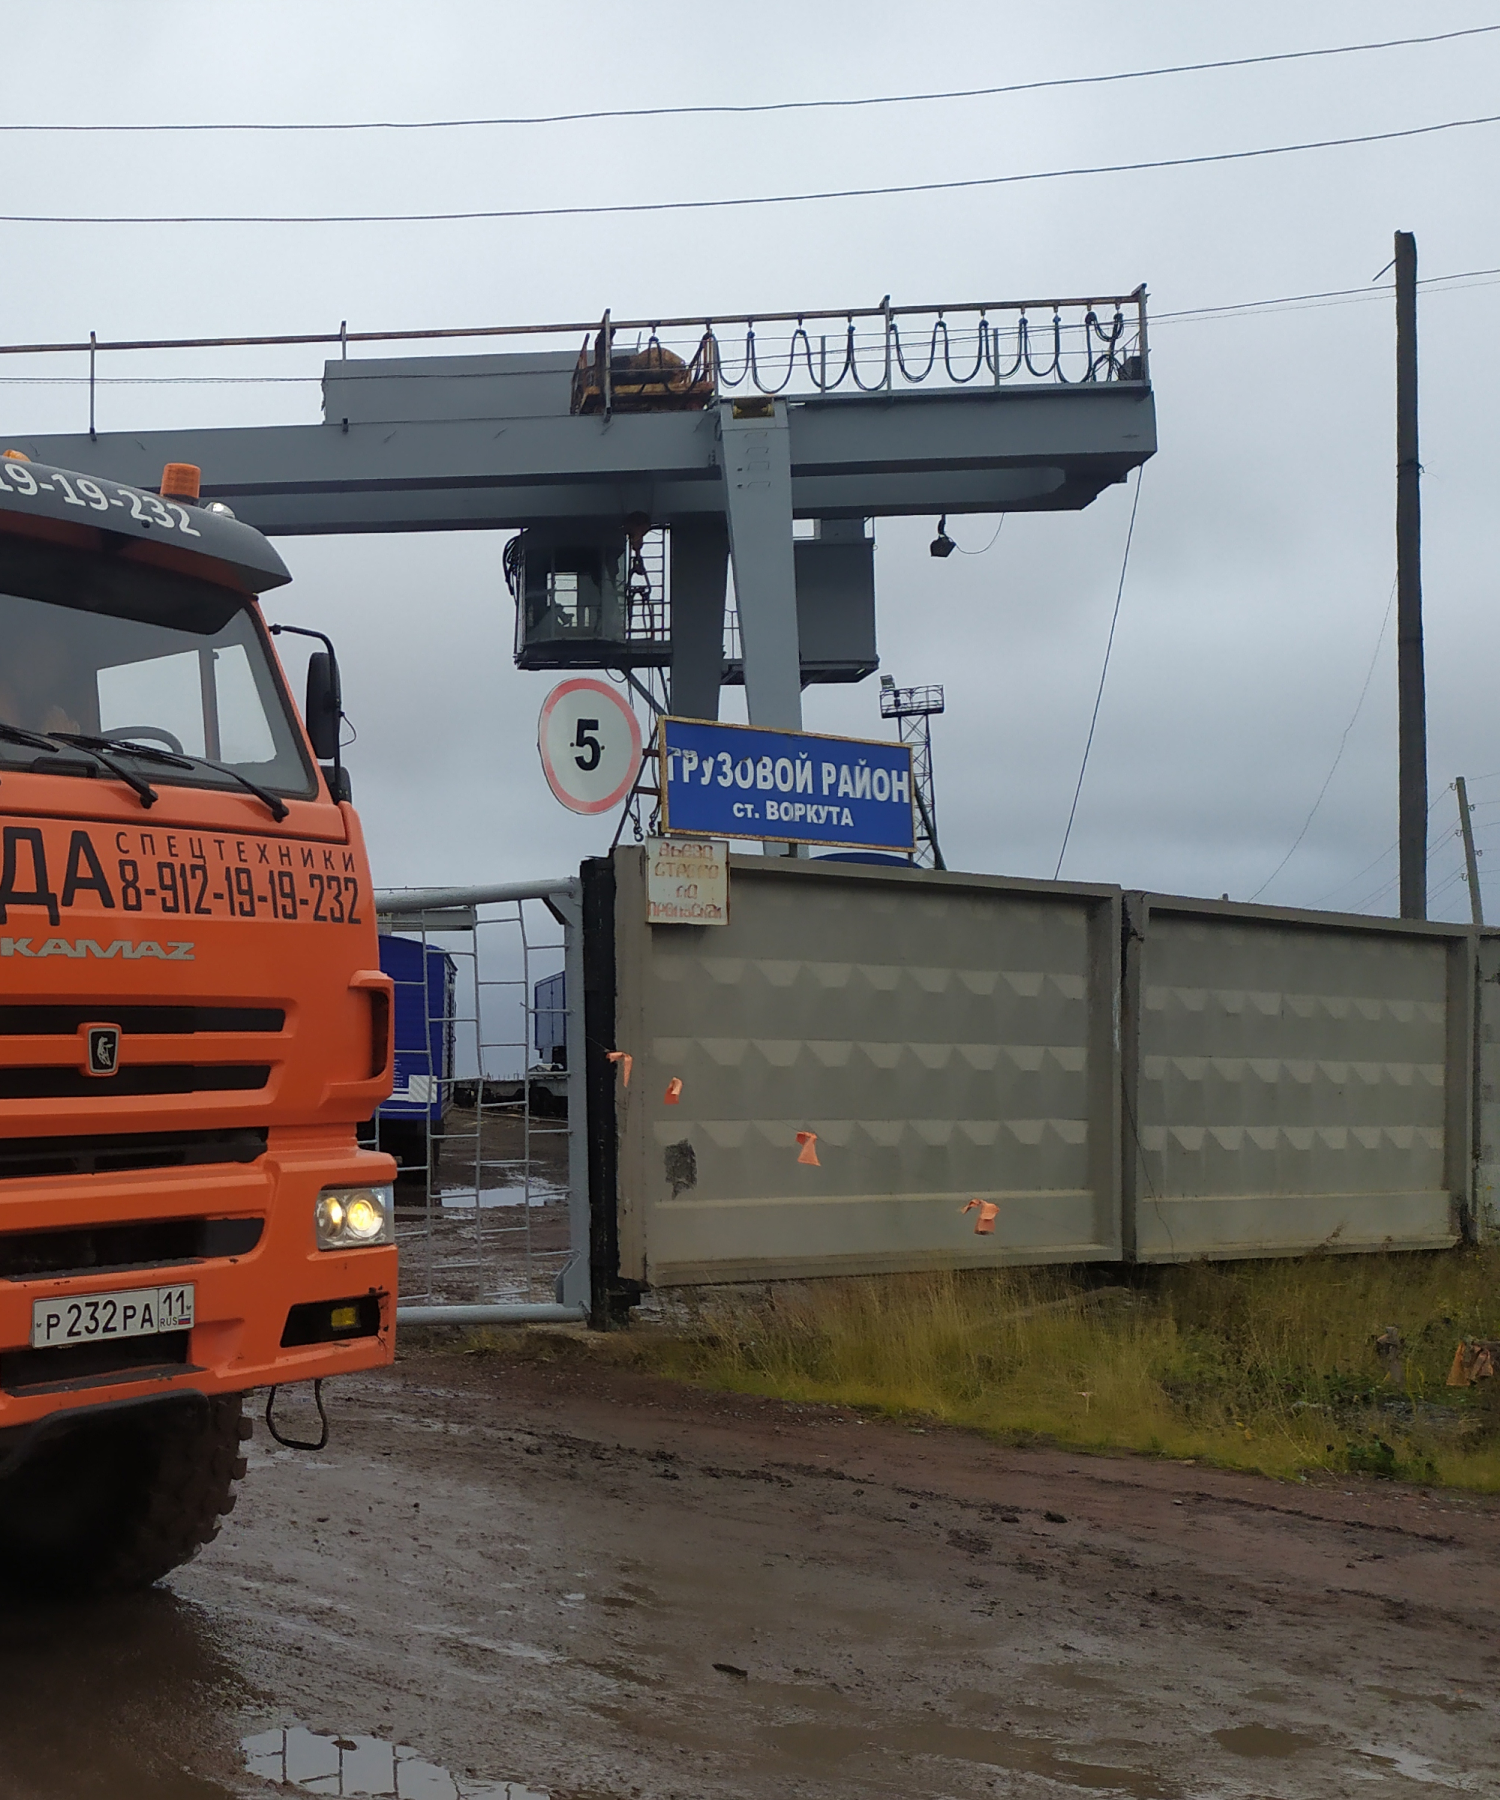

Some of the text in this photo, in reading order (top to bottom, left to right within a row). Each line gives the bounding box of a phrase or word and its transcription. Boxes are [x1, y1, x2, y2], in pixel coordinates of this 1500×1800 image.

[575, 718, 601, 771] 5
[667, 746, 910, 803] ГРУЗОВОЙ РАЙОН
[766, 800, 854, 827] ВОРКУТА
[115, 831, 356, 873] СПЕЦТЕХНИКИ
[118, 859, 362, 925] 8-912-19-19-232
[0, 937, 195, 961] KAMAZ
[160, 1317, 178, 1327] RUS
